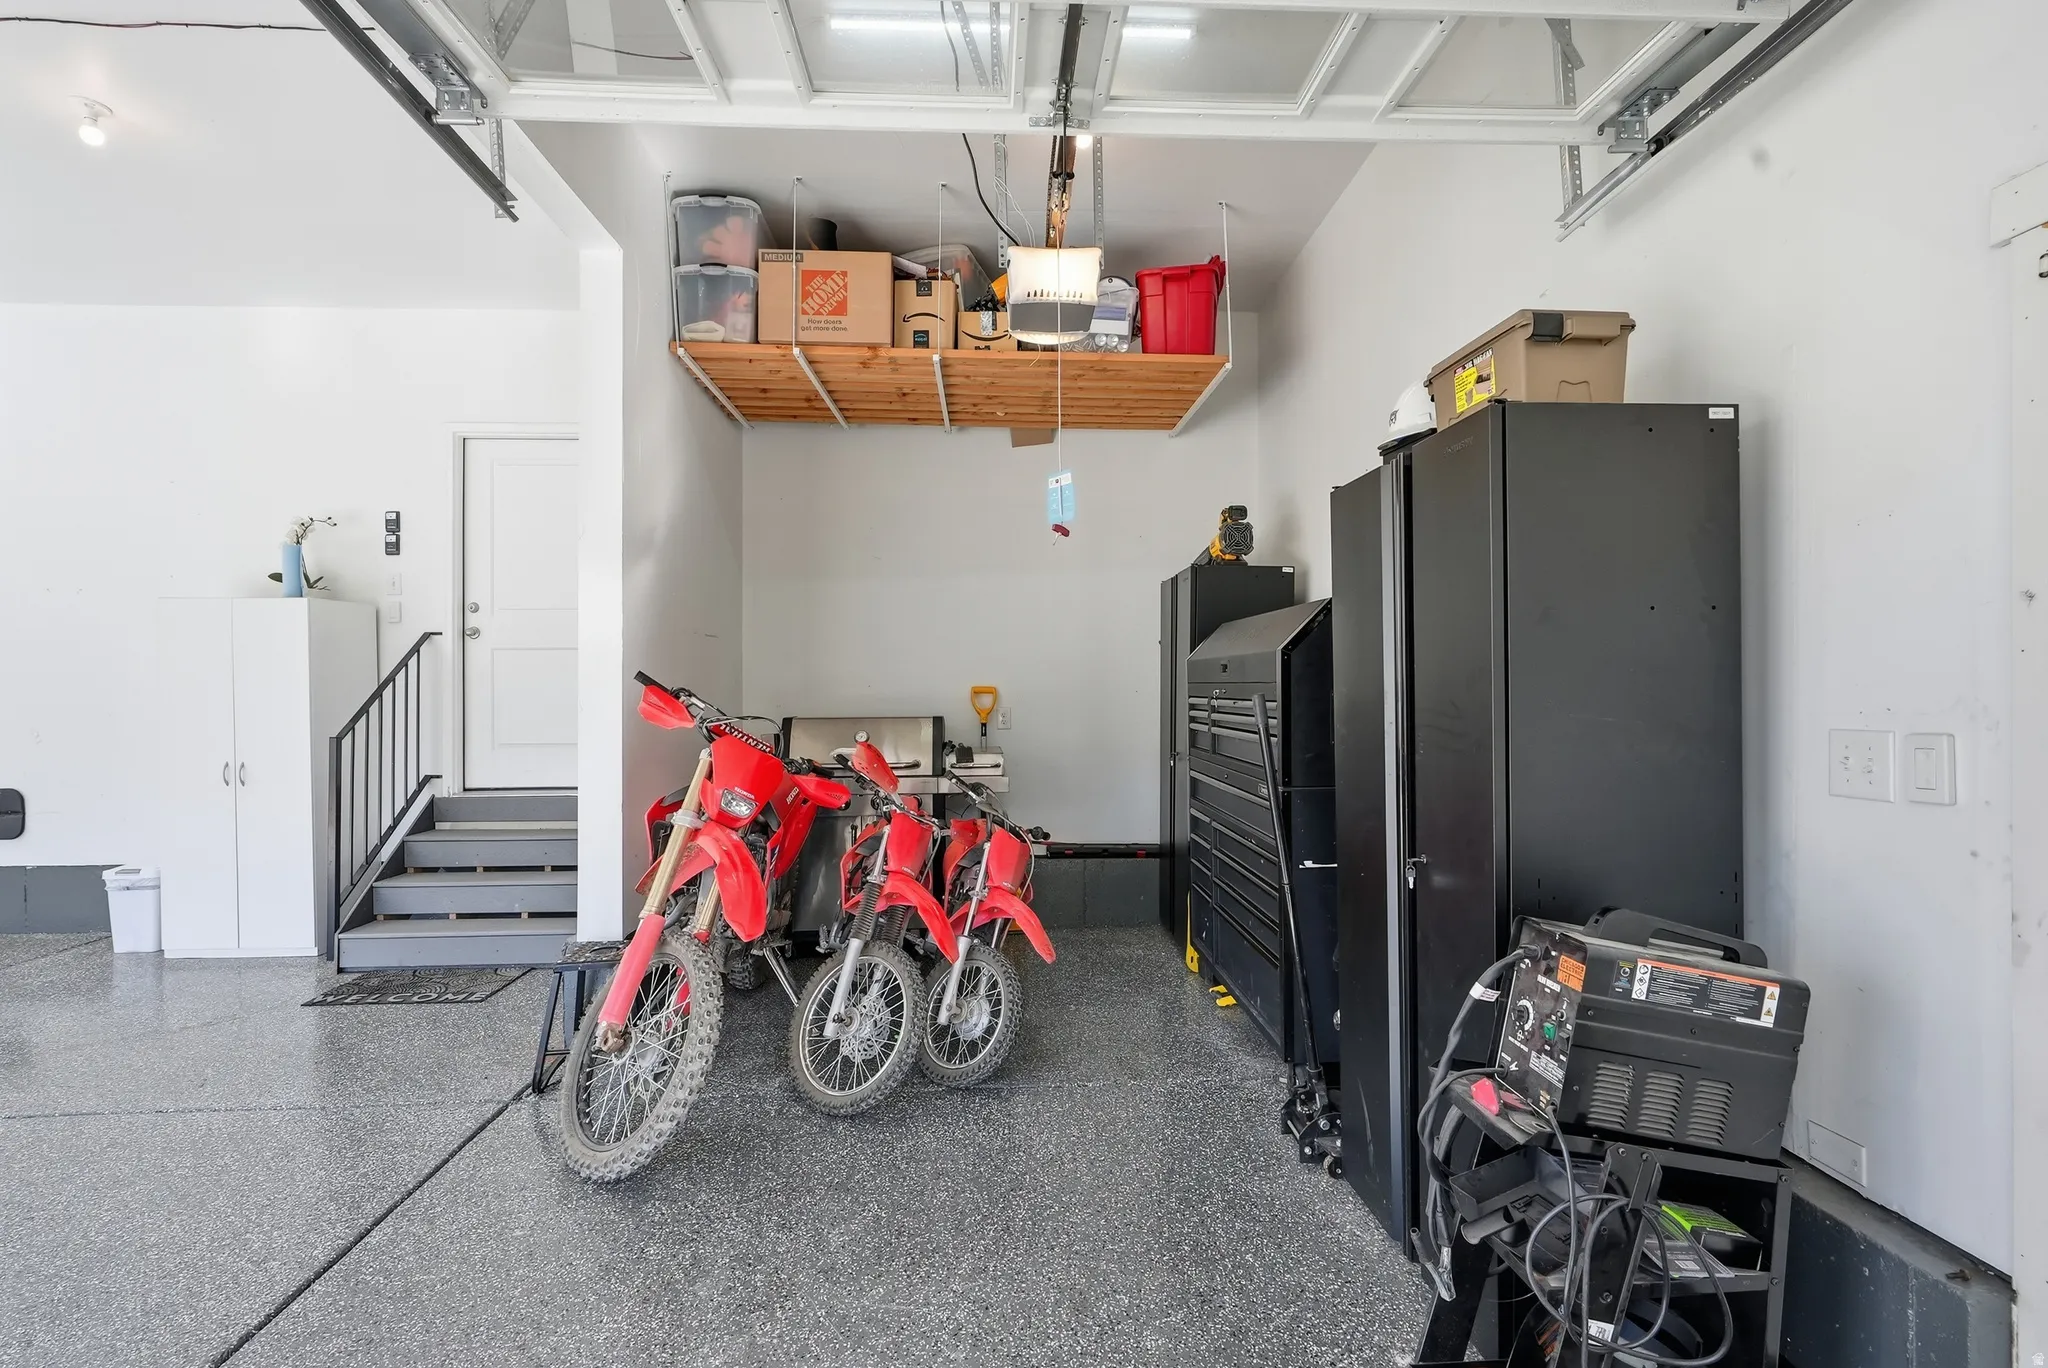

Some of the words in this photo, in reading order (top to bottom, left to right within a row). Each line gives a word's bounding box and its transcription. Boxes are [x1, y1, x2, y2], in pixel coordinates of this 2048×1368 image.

[801, 270, 847, 315] HOME
[805, 274, 826, 293] THE
[819, 287, 847, 316] DEPOT
[734, 786, 755, 800] HONDA
[313, 991, 492, 1003] WELCOME
